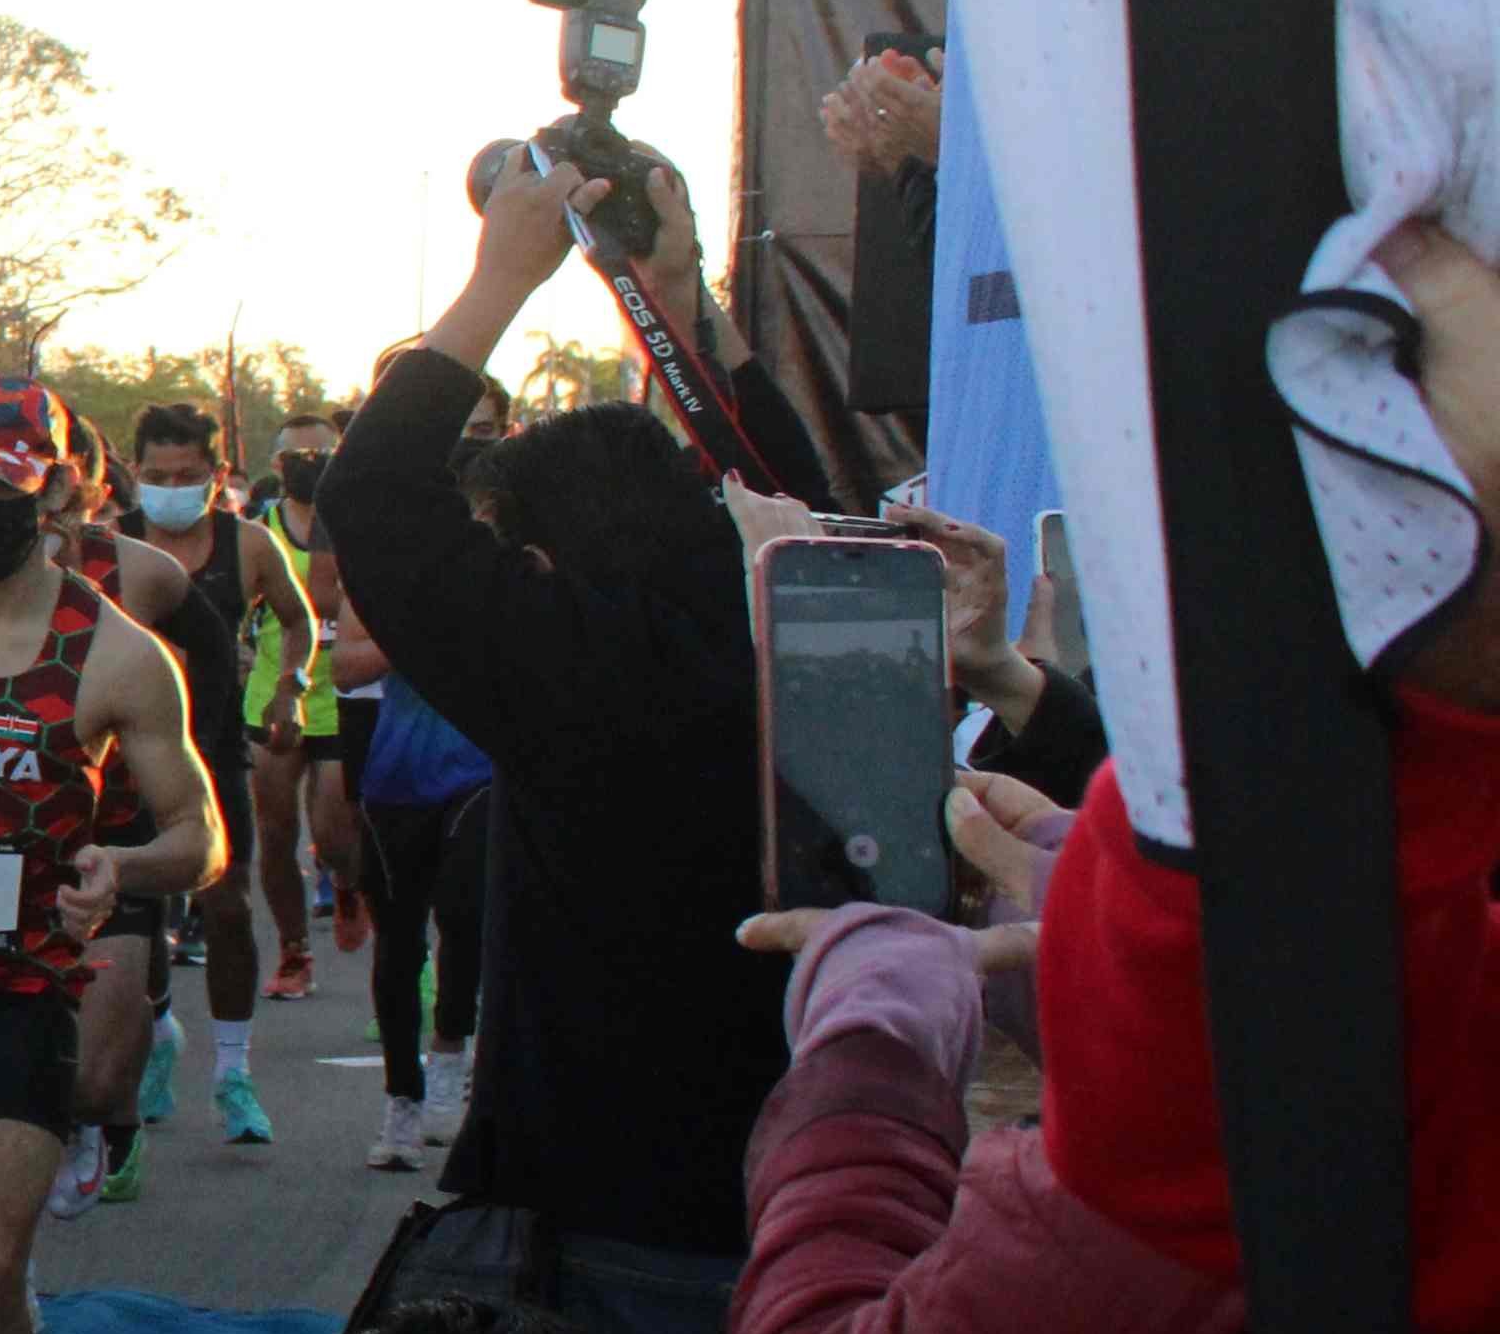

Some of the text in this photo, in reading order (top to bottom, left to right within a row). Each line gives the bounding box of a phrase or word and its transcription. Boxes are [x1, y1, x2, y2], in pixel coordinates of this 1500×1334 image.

[613, 275, 704, 414] EOS 5D Mark IV
